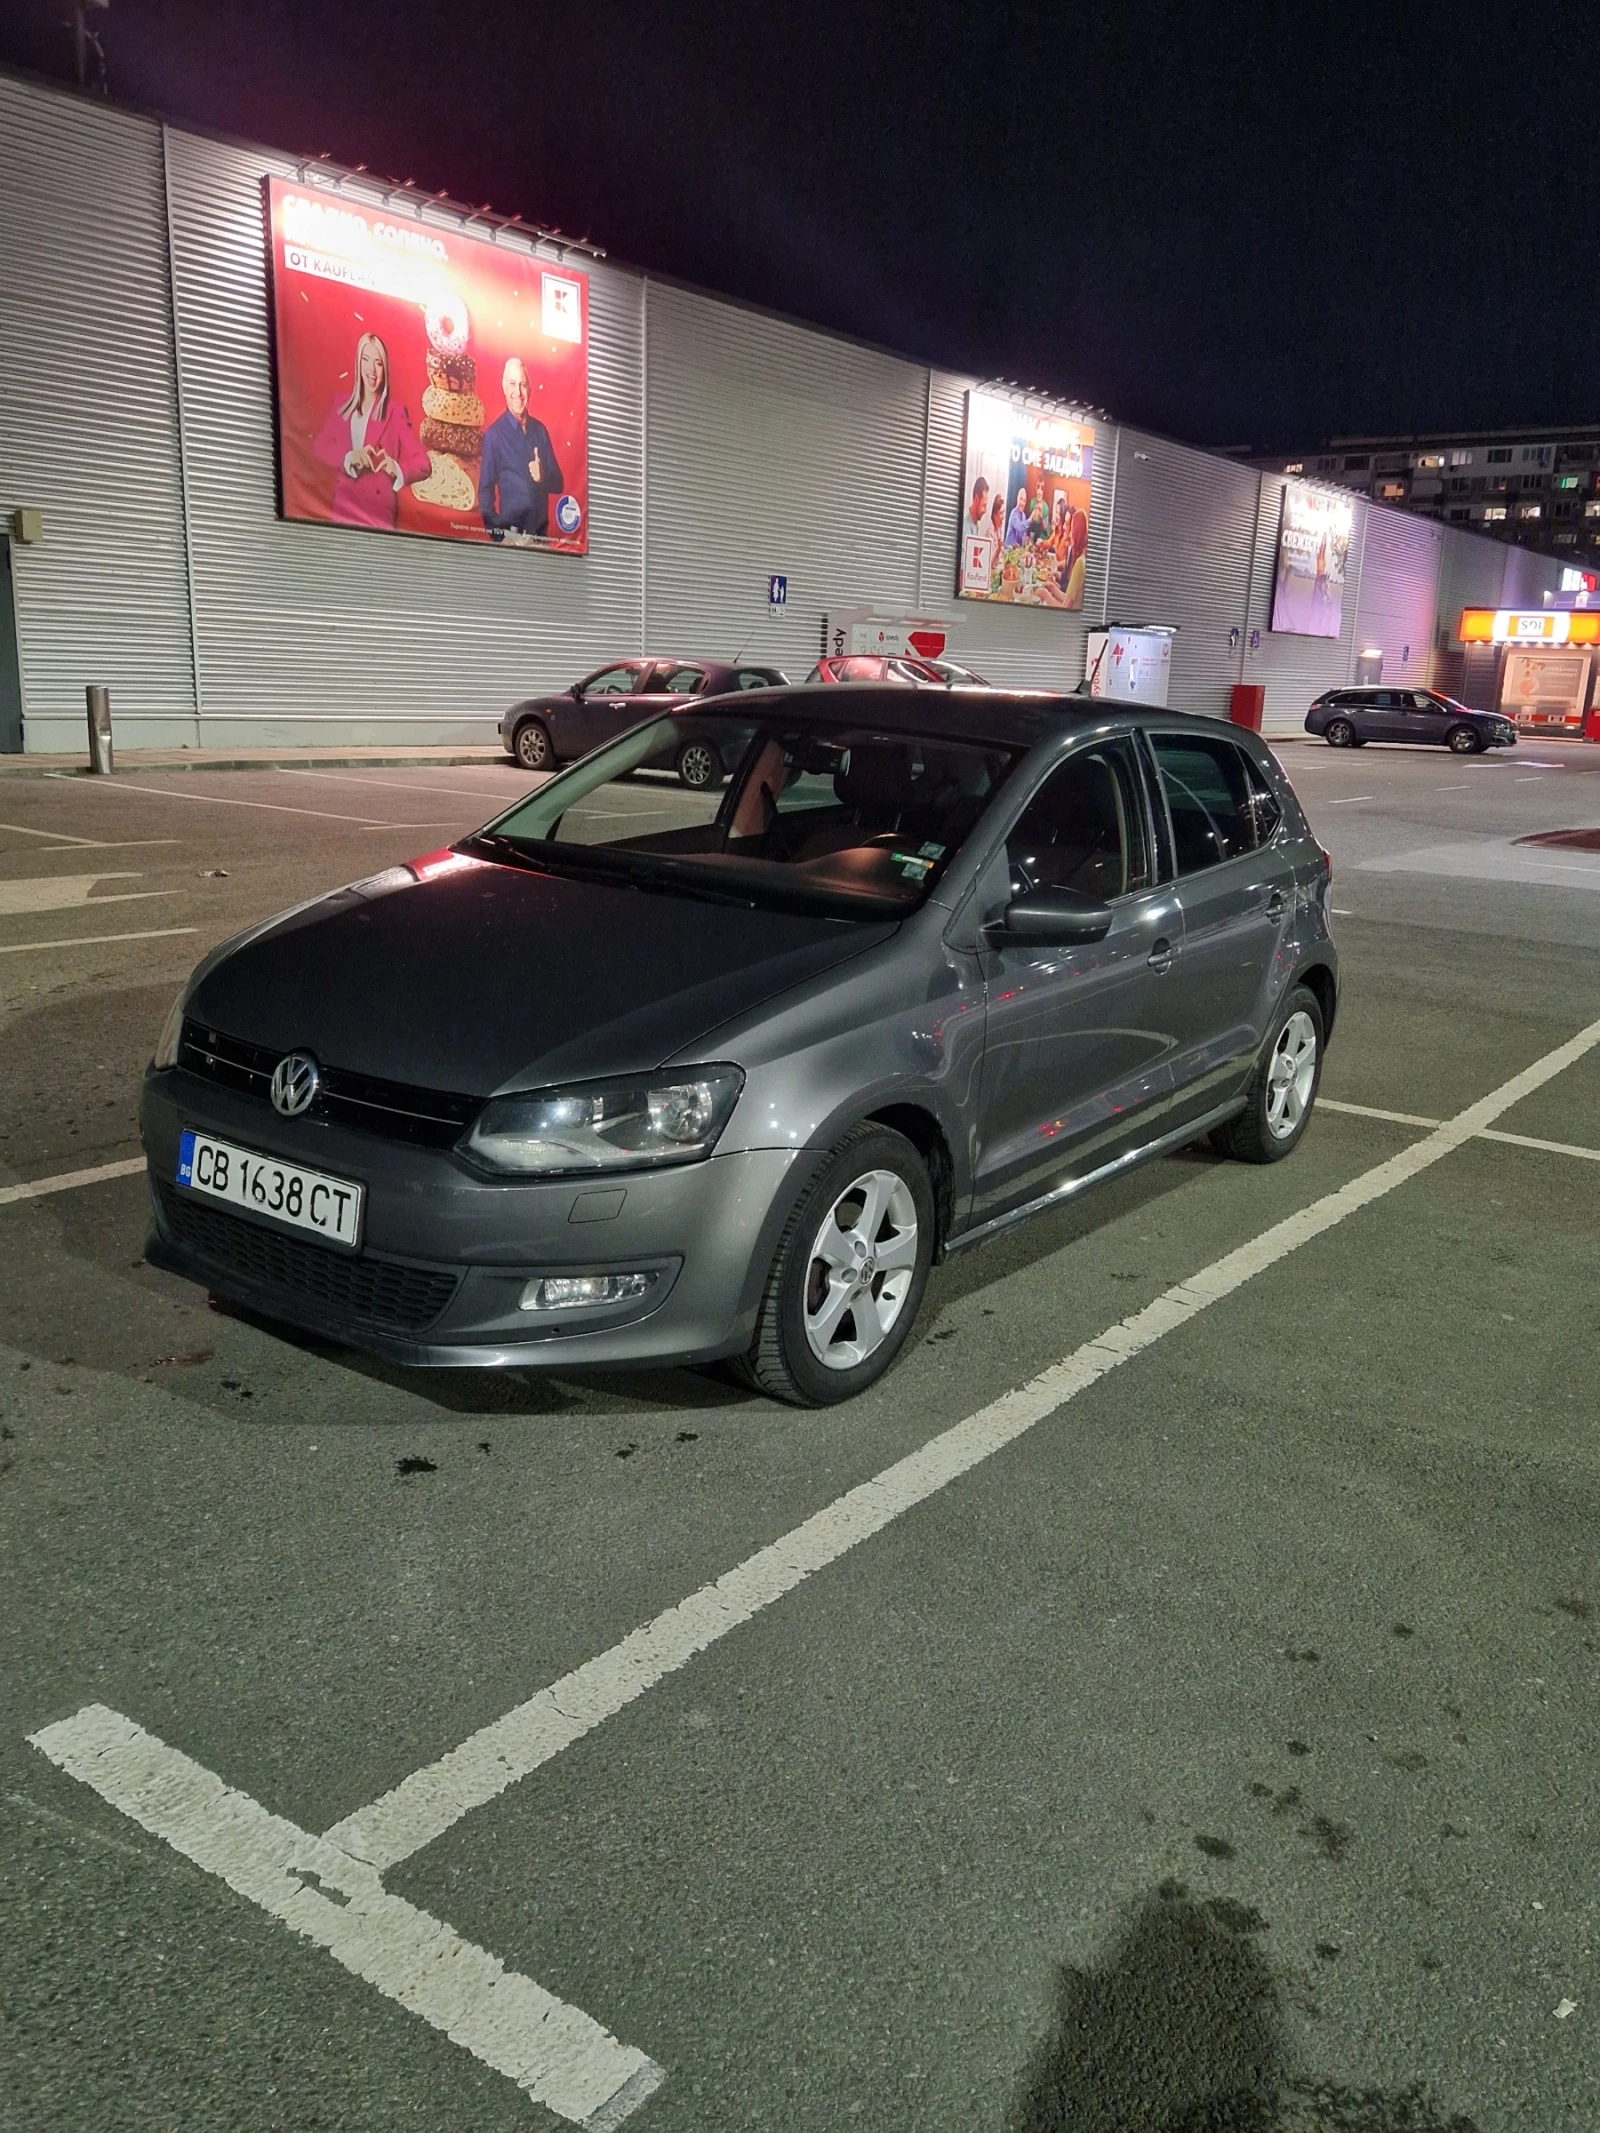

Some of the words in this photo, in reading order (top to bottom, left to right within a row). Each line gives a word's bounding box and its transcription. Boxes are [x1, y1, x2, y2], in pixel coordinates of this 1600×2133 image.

[290, 252, 309, 268] ОТ
[967, 572, 987, 582] Kaufland
[180, 1163, 191, 1178] BG
[196, 1145, 230, 1191] CB
[240, 1159, 304, 1218] 1638
[310, 1184, 352, 1233] CT
